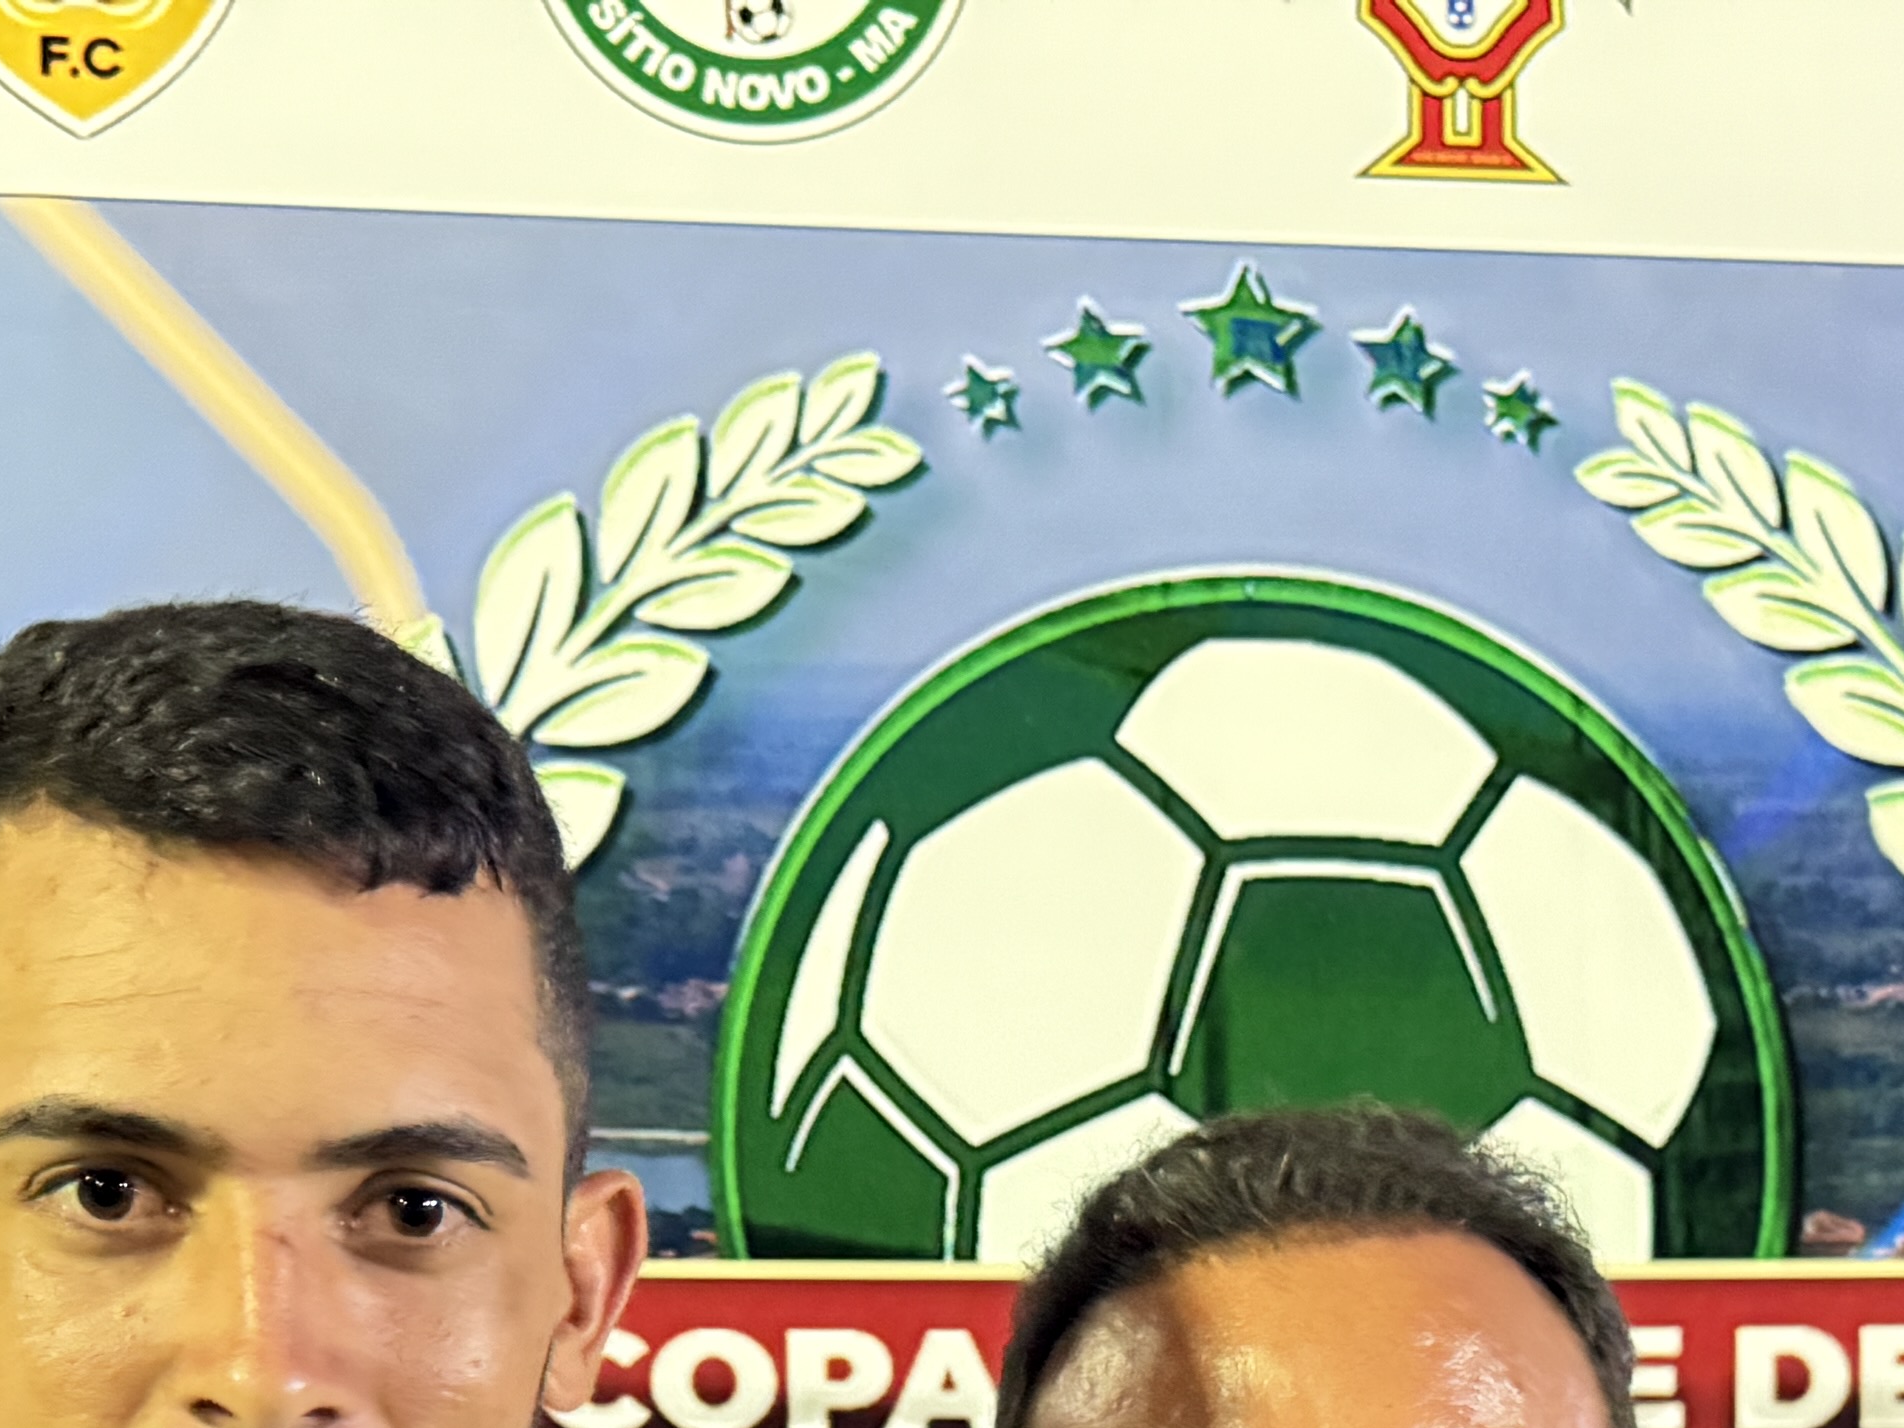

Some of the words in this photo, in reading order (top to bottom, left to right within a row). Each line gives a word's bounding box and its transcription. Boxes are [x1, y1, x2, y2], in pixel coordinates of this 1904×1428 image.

[39, 35, 123, 79] F.C
[586, 0, 698, 92] SÍTIO
[701, 65, 832, 111] NOVO
[846, 6, 920, 74] MA
